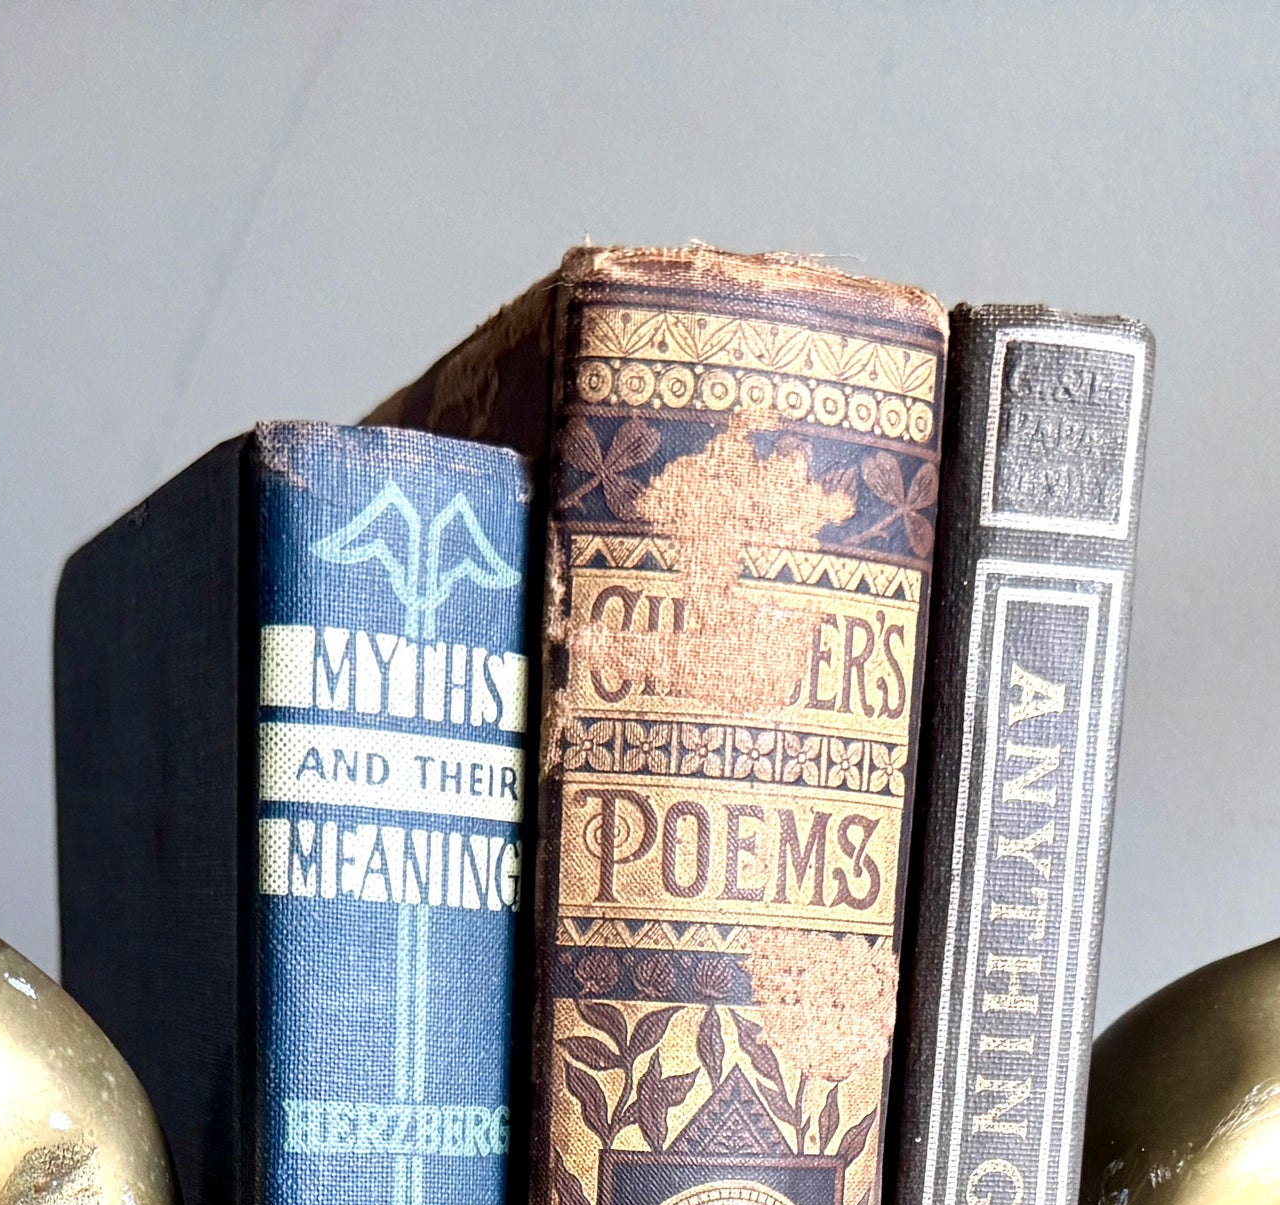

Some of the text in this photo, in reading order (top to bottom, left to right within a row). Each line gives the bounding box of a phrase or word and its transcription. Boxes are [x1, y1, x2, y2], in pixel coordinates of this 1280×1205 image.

[313, 629, 508, 730] MYTHS
[296, 747, 519, 800] AND THEIR
[287, 819, 520, 911] MEANING
[574, 787, 882, 912] POEMS
[283, 1098, 511, 1157] HERZBERG
